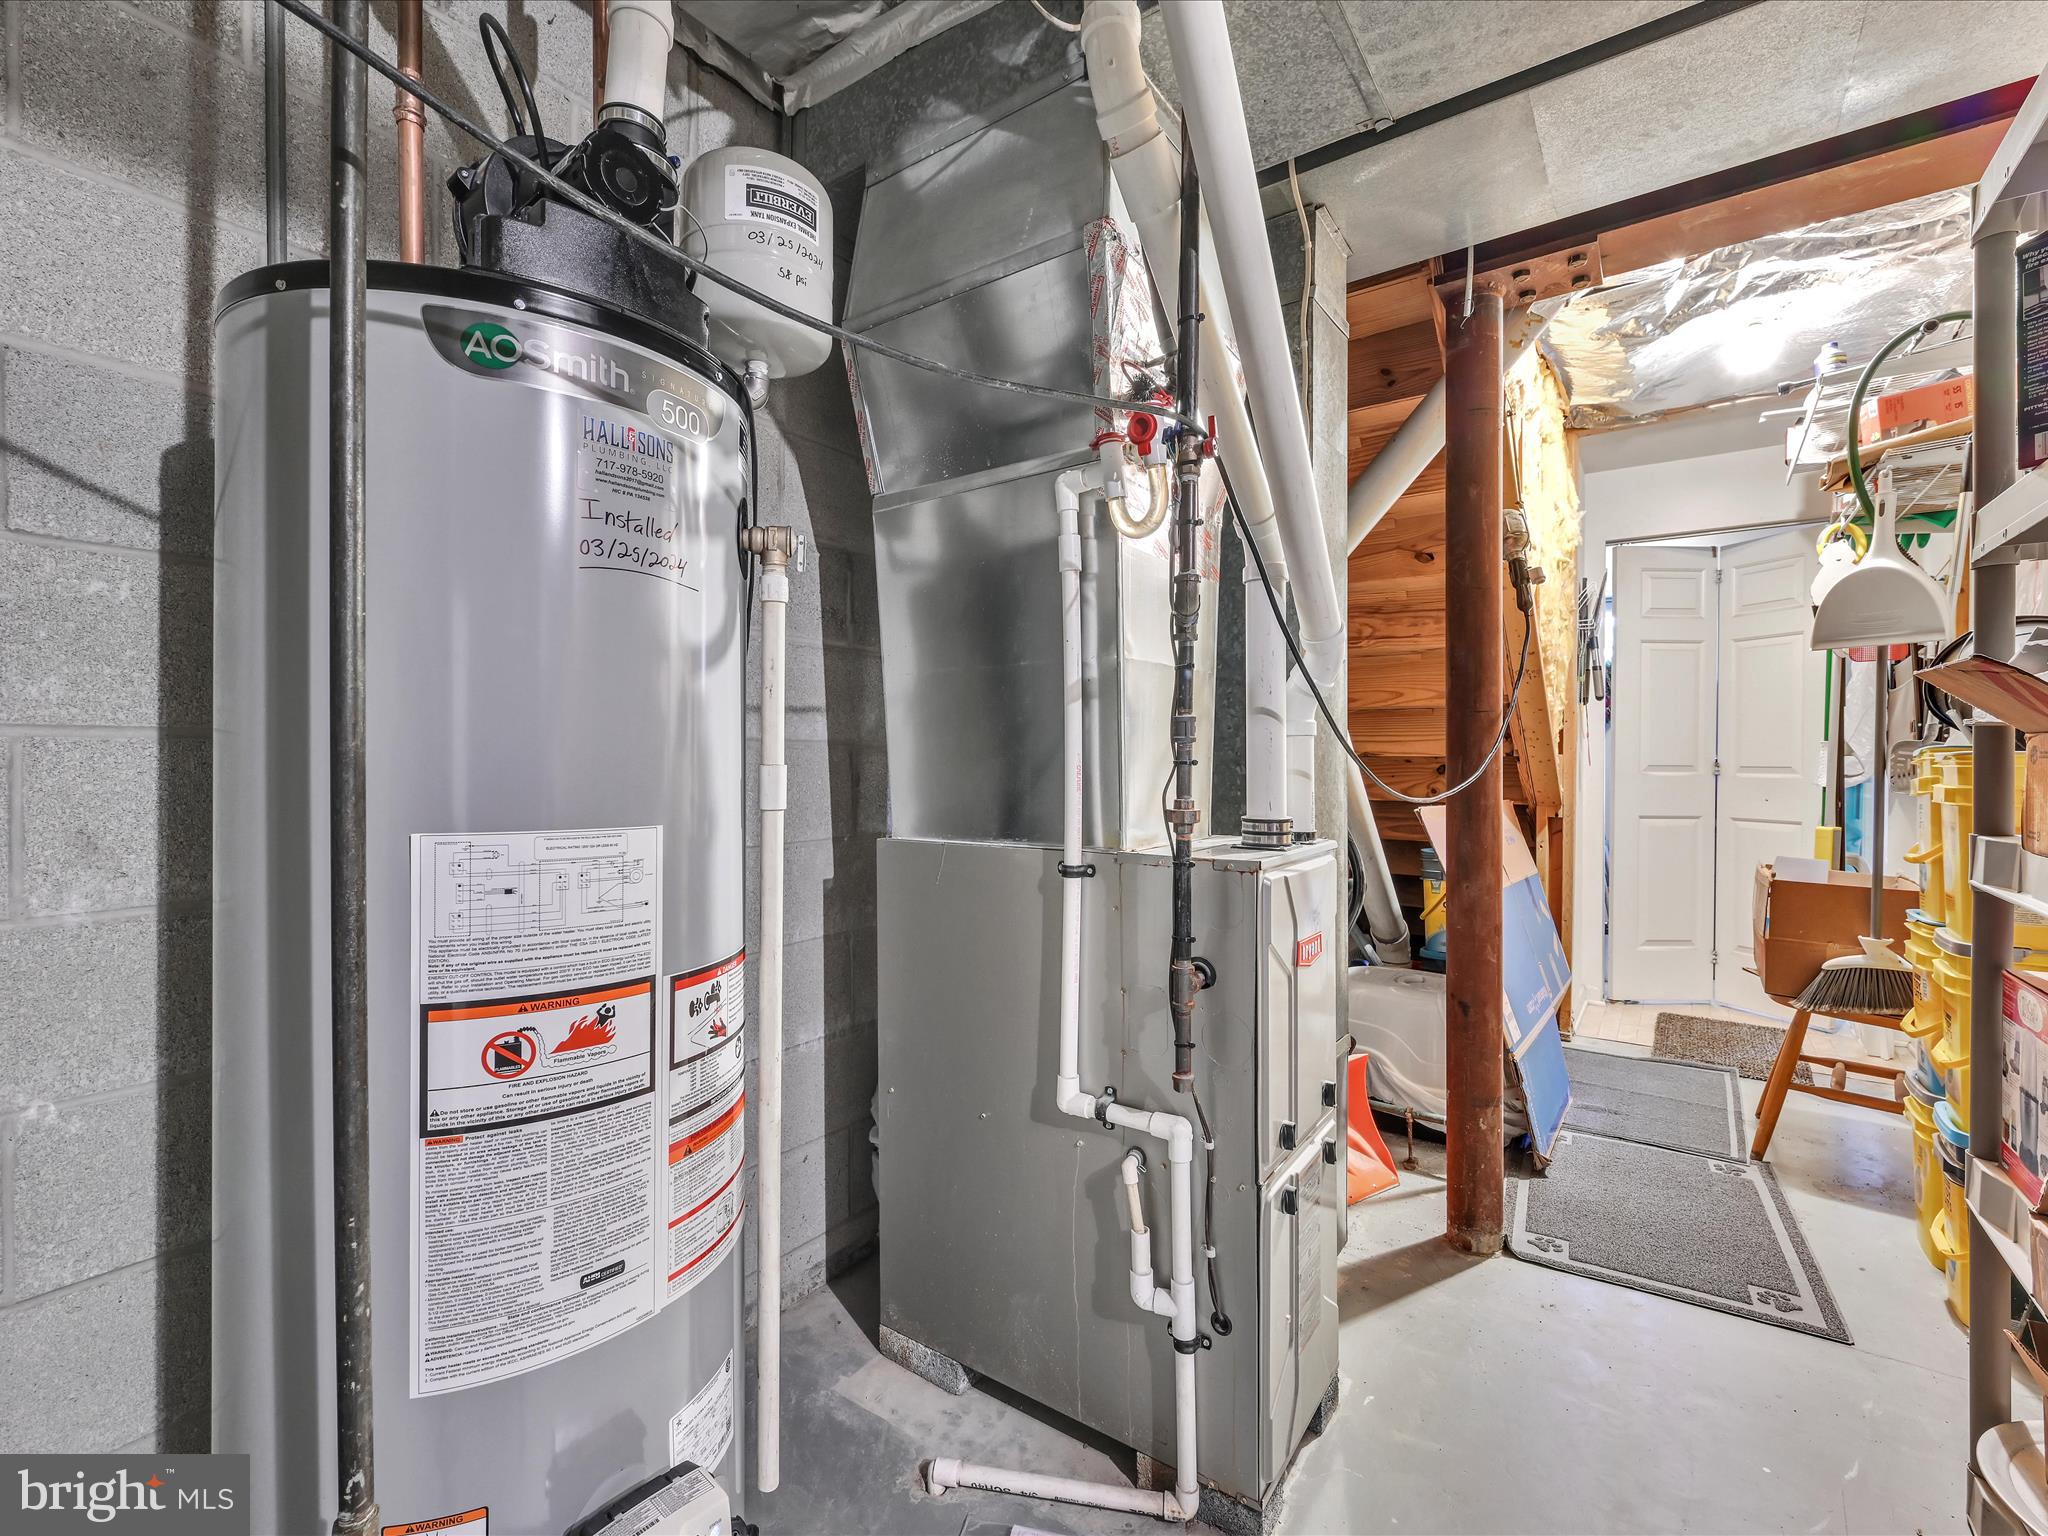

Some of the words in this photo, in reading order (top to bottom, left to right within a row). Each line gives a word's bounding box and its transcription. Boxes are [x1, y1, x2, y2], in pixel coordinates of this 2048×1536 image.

[754, 191, 813, 220] EVERBILT
[750, 210, 765, 220] TANK
[766, 214, 797, 229] EXPANSION
[797, 224, 817, 242] THERMAL
[661, 399, 700, 436] 500
[583, 416, 629, 450] HALL
[638, 432, 673, 464] SONS
[596, 458, 664, 484] 717-978-5920
[657, 463, 672, 474] LLC
[578, 498, 679, 543] Installed
[580, 538, 688, 578] 03/25/2024
[530, 997, 580, 1012] WARNING
[553, 1054, 586, 1064] Flammable
[587, 1049, 607, 1058] Vapors
[535, 1075, 566, 1085] EXPLOSION
[567, 1070, 589, 1079] HAZARD
[494, 1101, 517, 1110] gasoline
[541, 1092, 567, 1101] flammable
[568, 1088, 585, 1096] vapors
[506, 1106, 527, 1114] Storage
[559, 1095, 580, 1103] gasoline
[601, 1084, 624, 1093] flammable
[486, 1131, 507, 1139] against
[415, 1516, 464, 1531] WARNING
